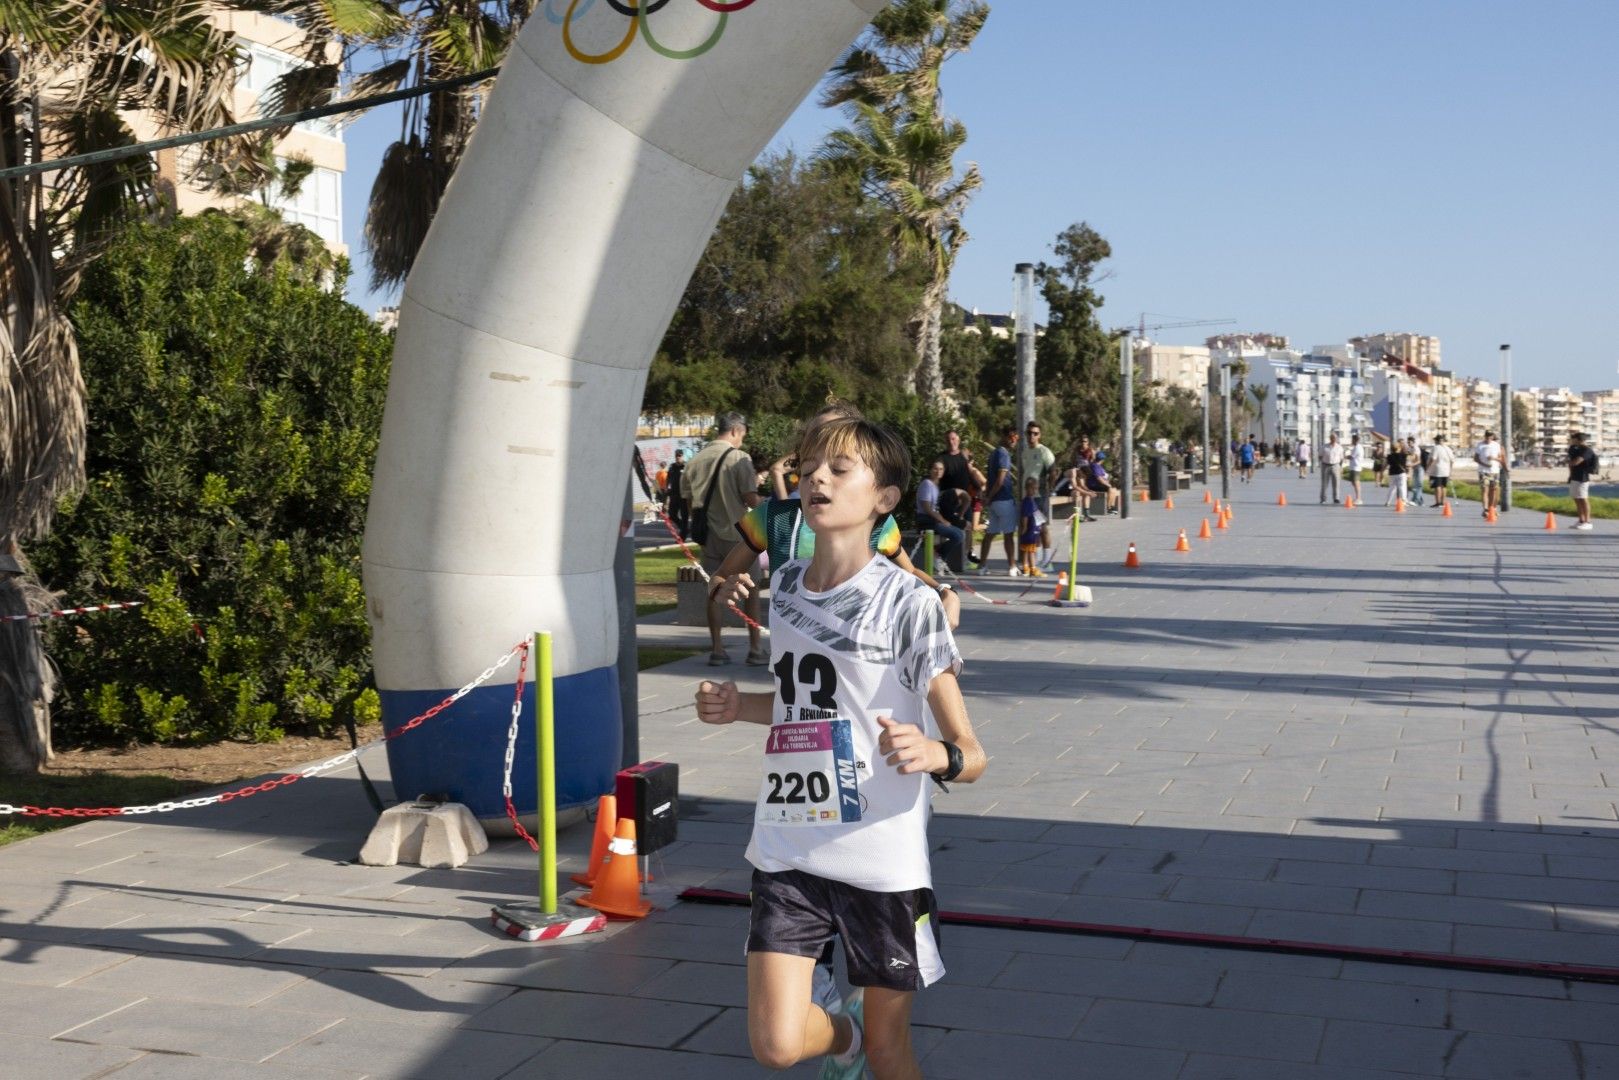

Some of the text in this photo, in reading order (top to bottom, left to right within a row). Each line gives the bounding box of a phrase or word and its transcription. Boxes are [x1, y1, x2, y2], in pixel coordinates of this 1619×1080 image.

[766, 771, 830, 804] 220
[837, 758, 858, 806] 7 KM
